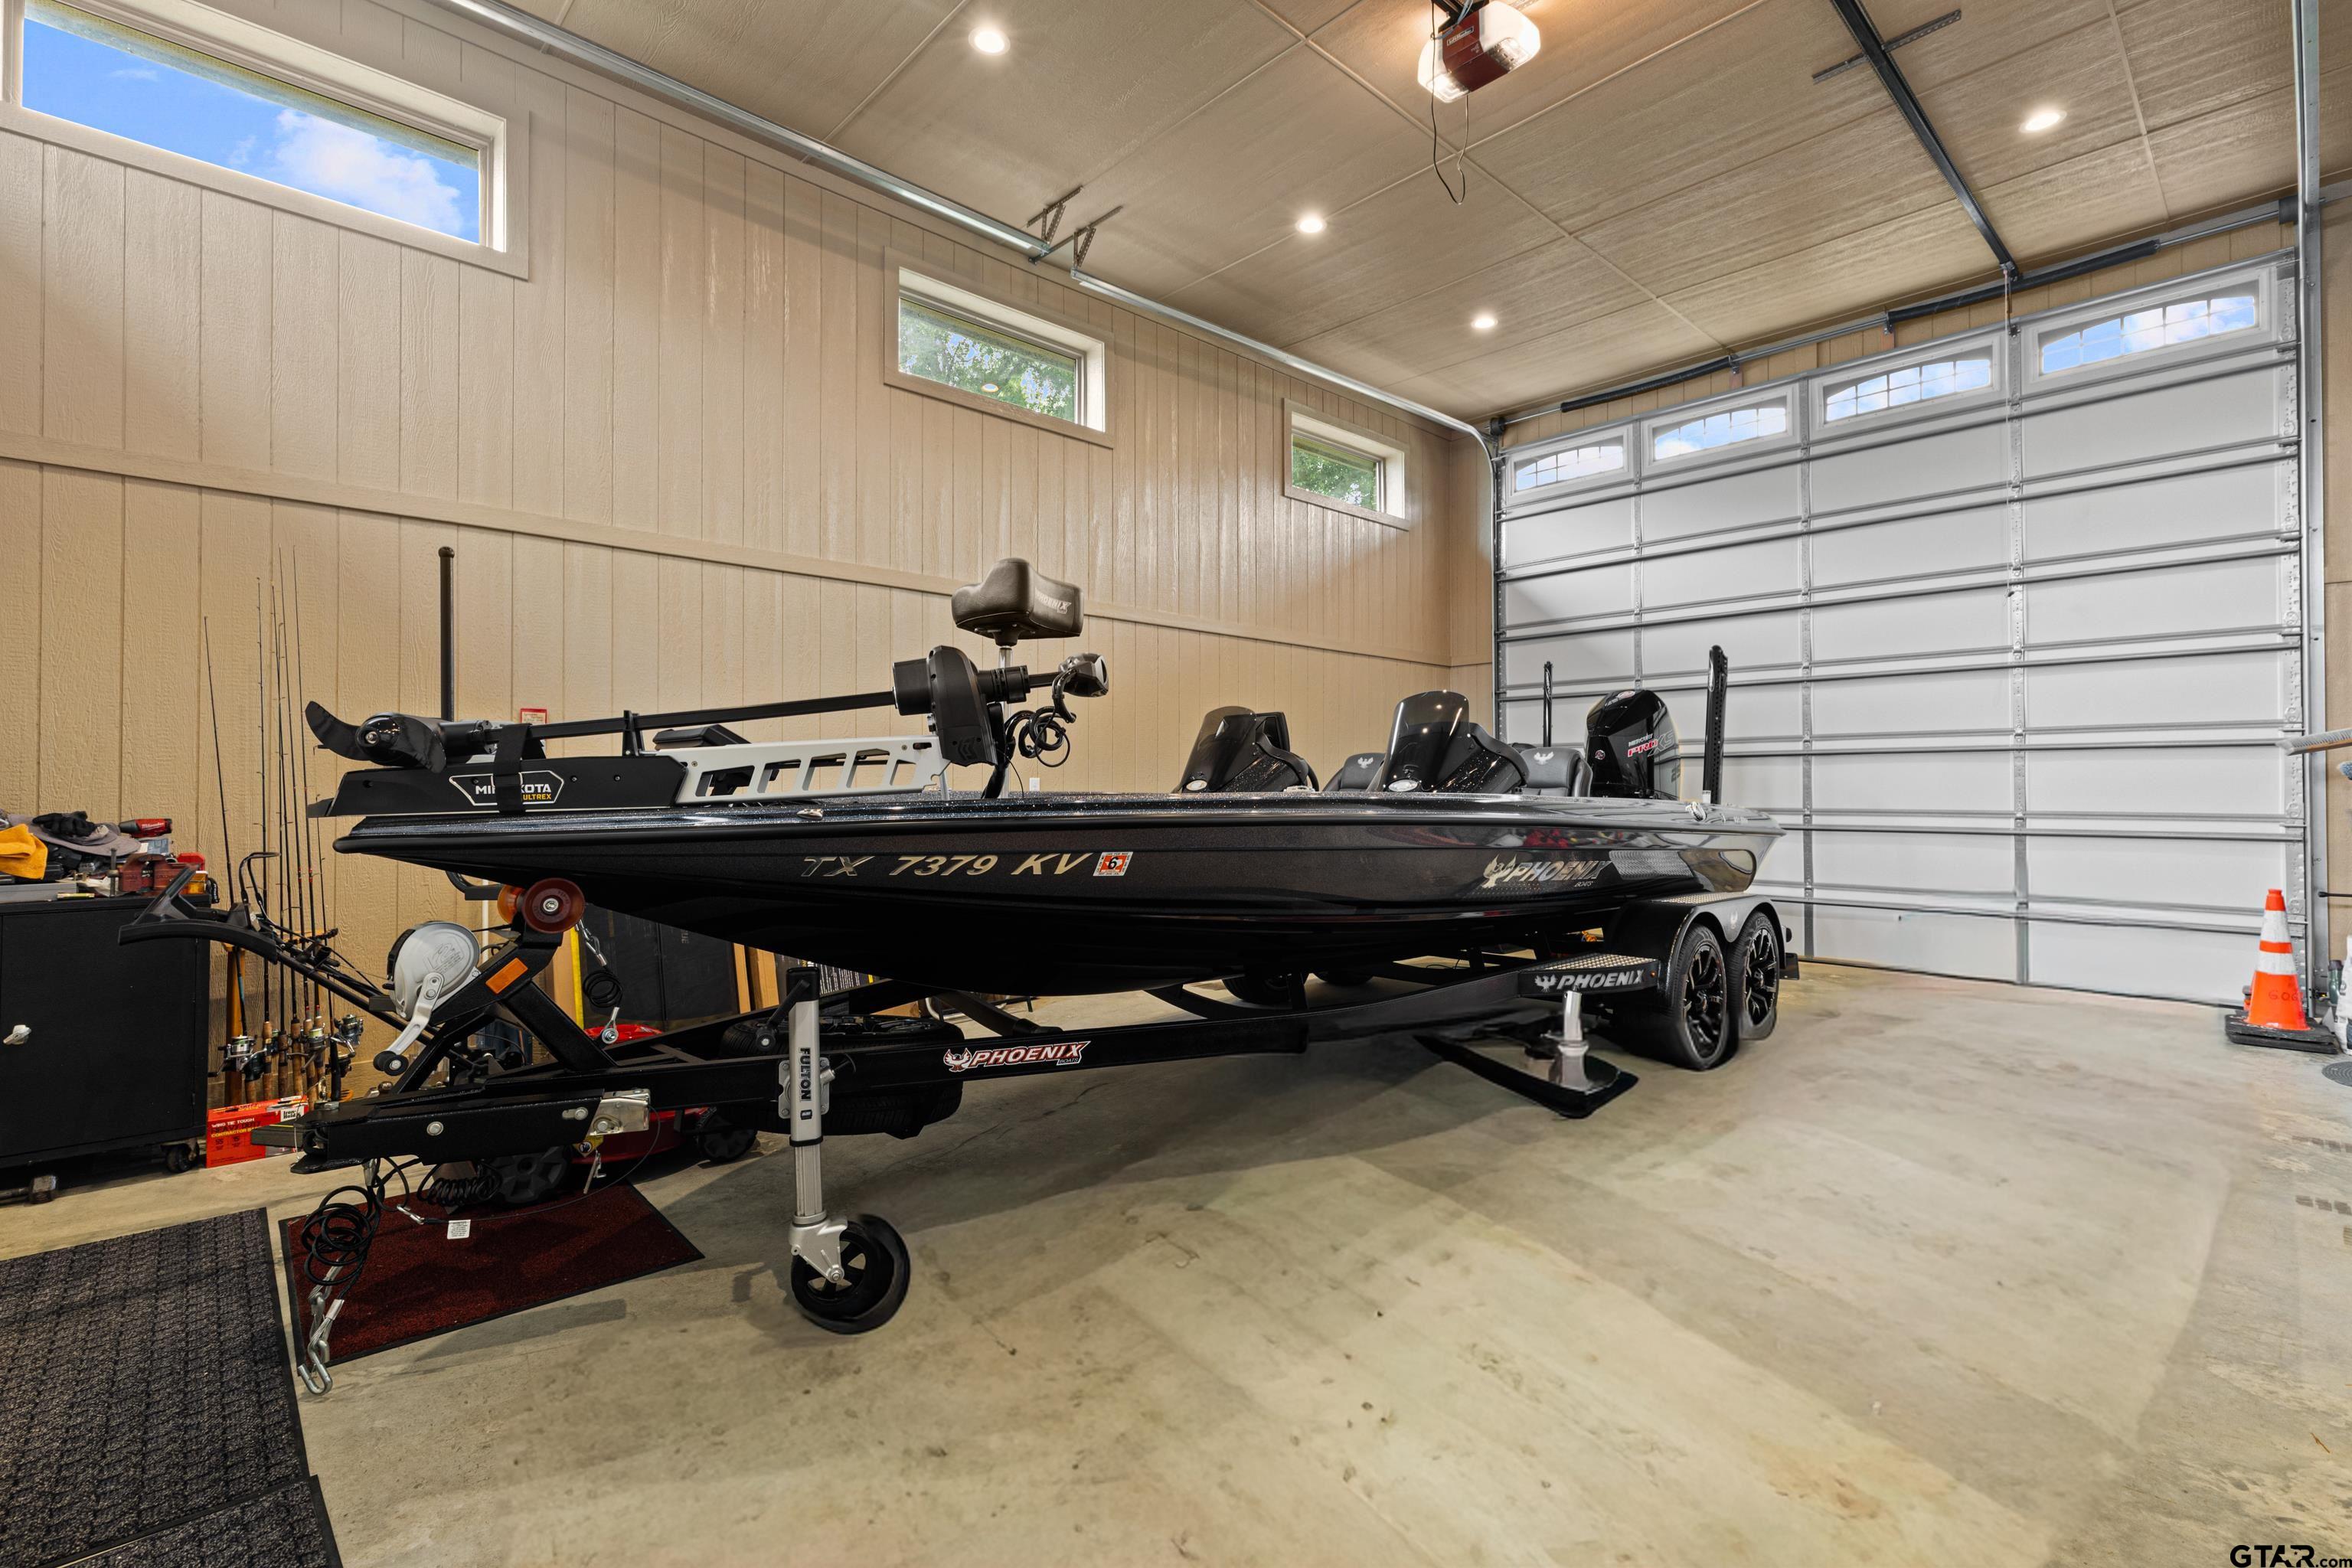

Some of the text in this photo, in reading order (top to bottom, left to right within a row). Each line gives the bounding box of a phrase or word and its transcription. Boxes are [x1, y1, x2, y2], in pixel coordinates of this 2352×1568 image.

[801, 852, 1094, 877] TX 7379 KV
[1108, 857, 1119, 870] 6
[1503, 861, 1612, 882] PHOENIX
[1557, 969, 1644, 990] PHOENIX
[969, 1041, 1088, 1067] PHOENIX
[799, 1047, 812, 1101] FULTON
